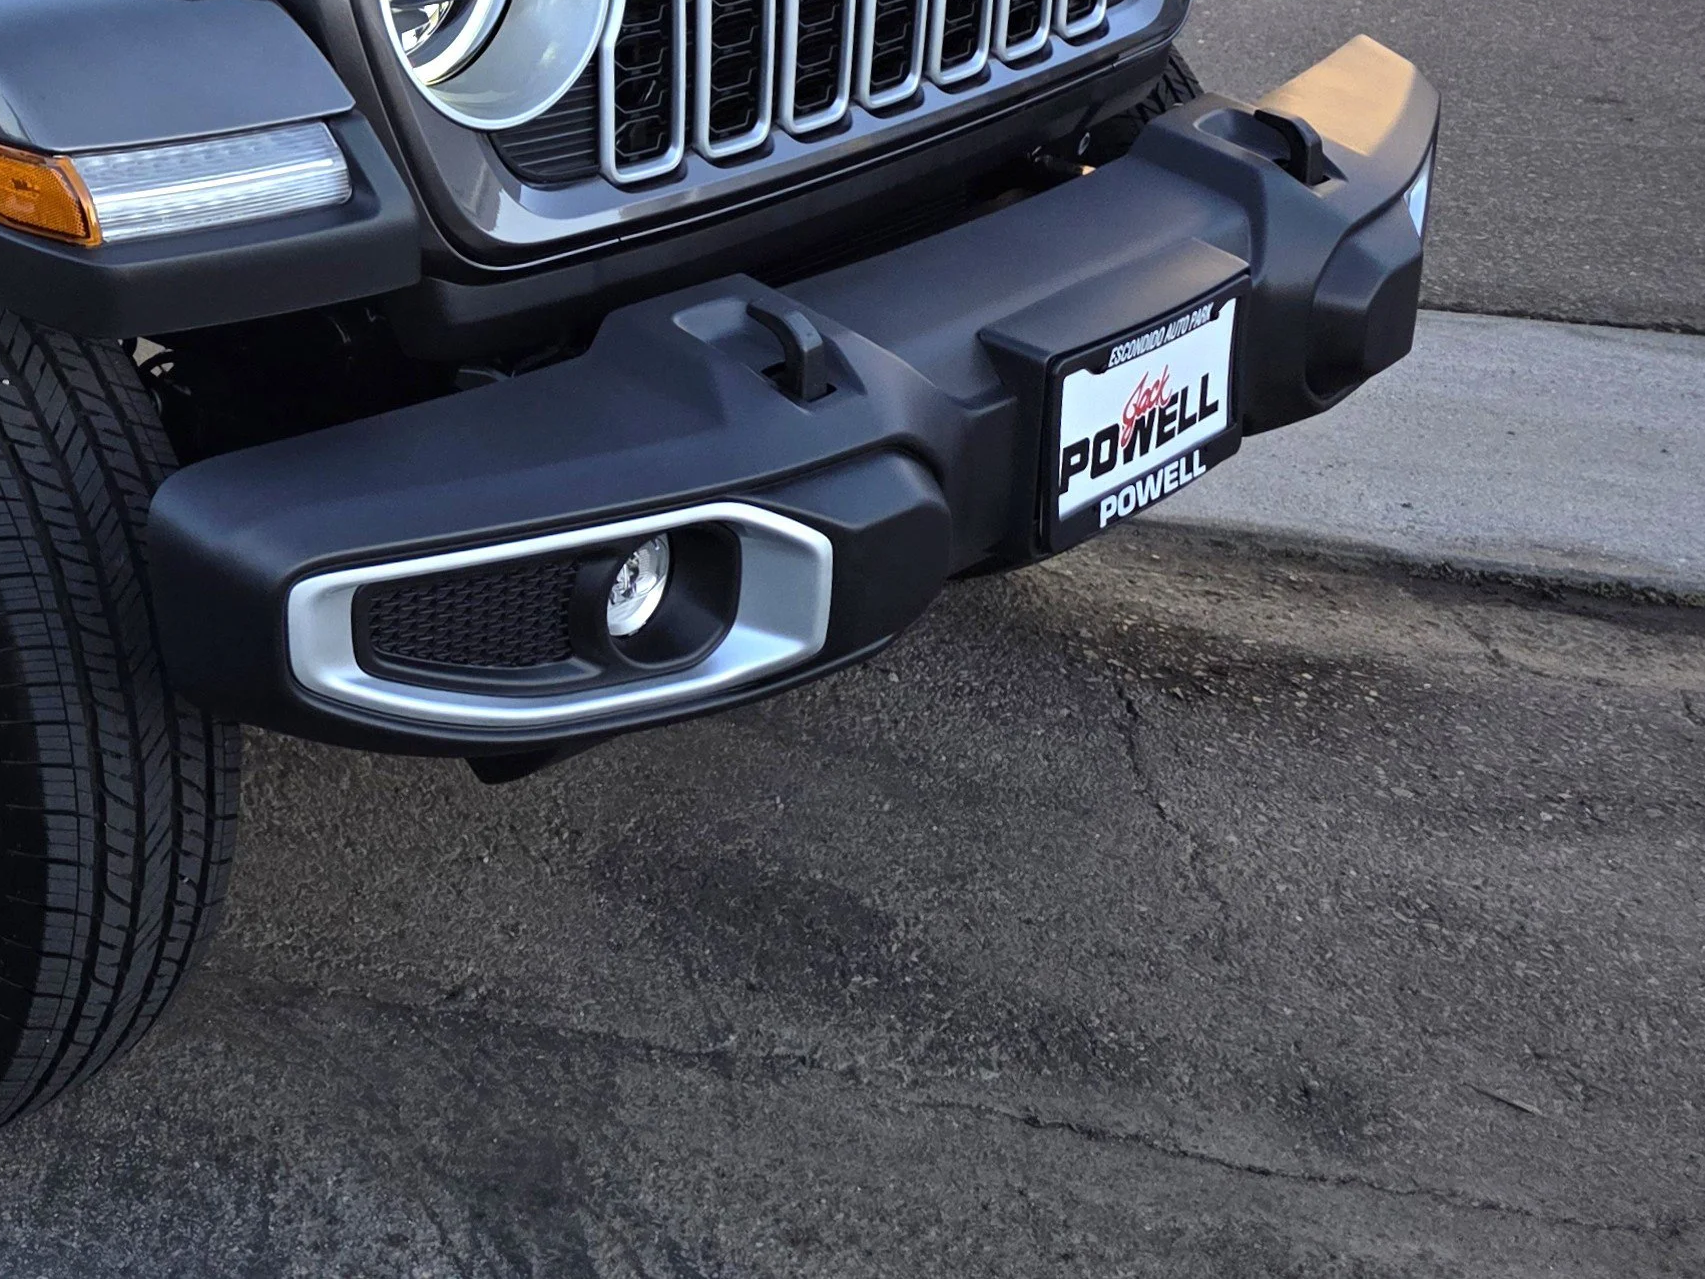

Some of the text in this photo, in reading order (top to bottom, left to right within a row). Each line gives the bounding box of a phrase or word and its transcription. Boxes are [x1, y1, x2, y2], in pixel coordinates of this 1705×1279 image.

[1108, 302, 1215, 367] ESCONDIDO AUTO PARK
[1060, 373, 1219, 495] POWELL
[1099, 449, 1207, 529] POWELL
